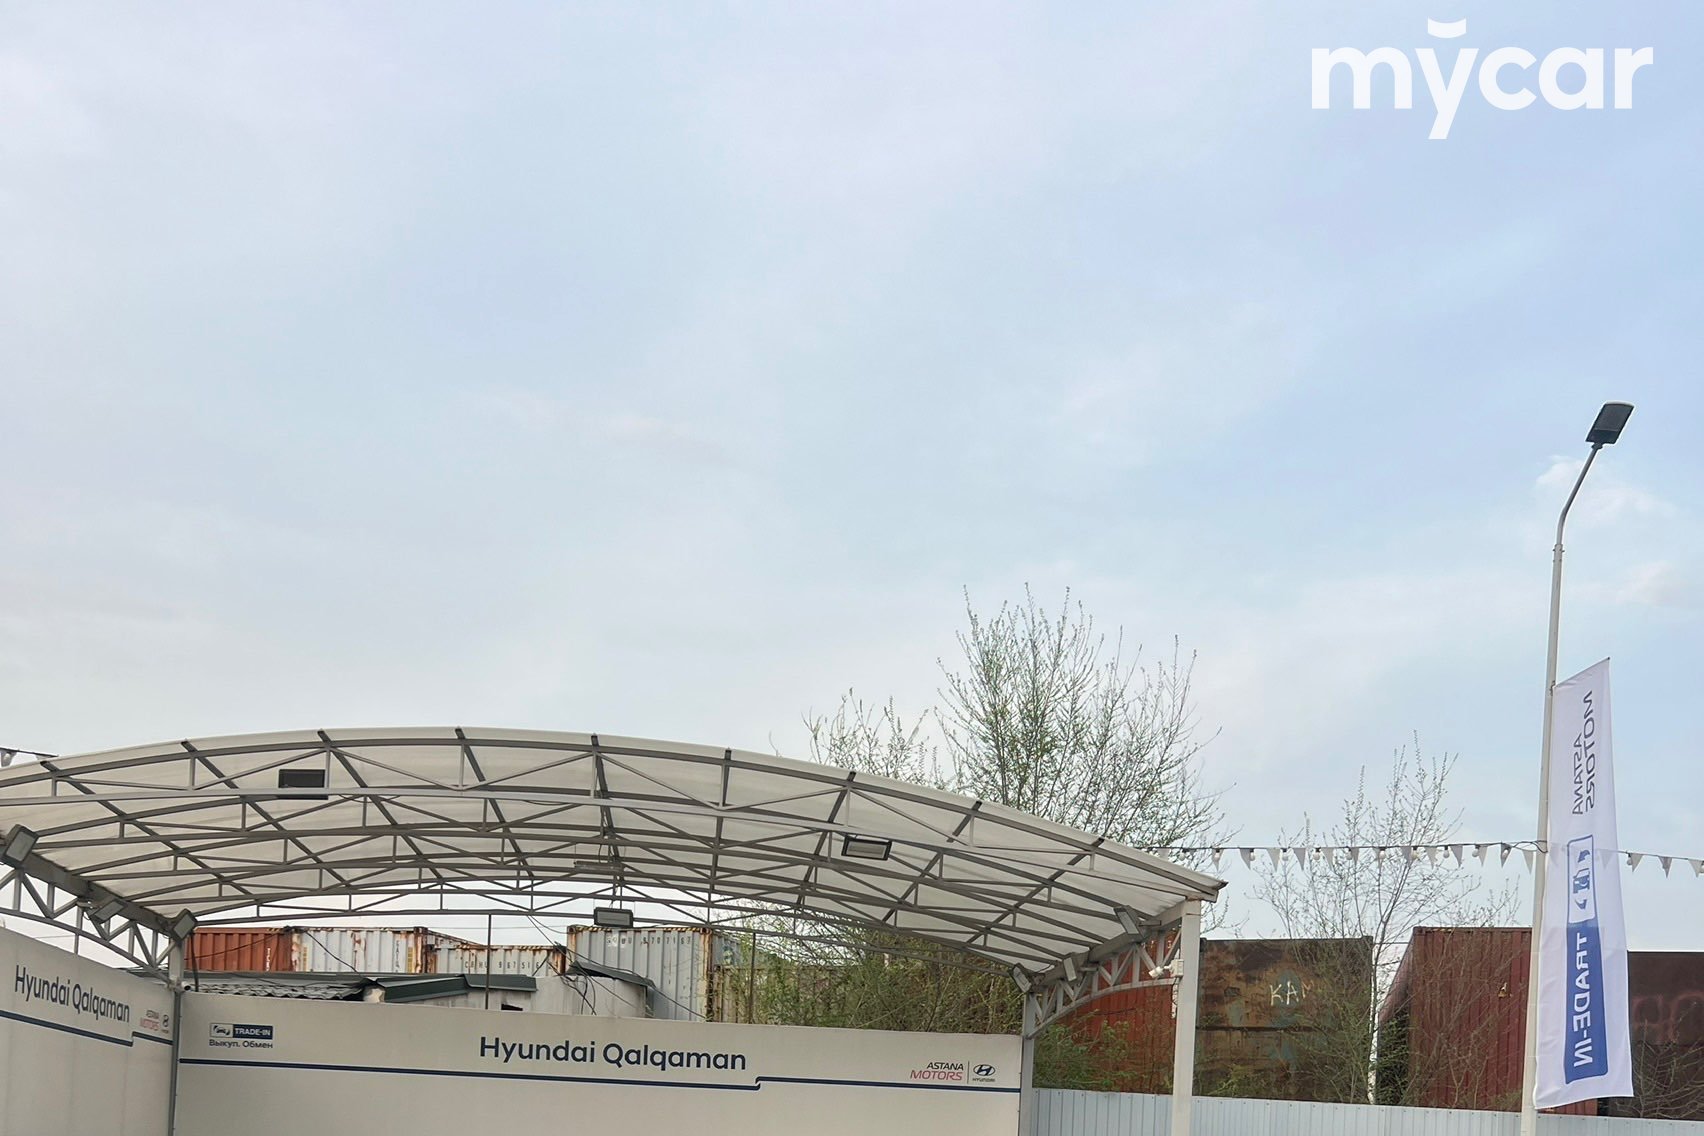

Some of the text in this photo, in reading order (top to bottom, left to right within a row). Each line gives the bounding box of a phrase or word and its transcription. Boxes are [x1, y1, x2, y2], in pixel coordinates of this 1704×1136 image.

[14, 964, 130, 1022] Hyundai Qalqaman
[234, 1028, 271, 1037] TRADE-IN
[242, 1040, 274, 1049] Обмен
[479, 1036, 747, 1072] Hyundai Qalqaman
[926, 1061, 964, 1071] ASTANA
[909, 1069, 963, 1081] MOTORS
